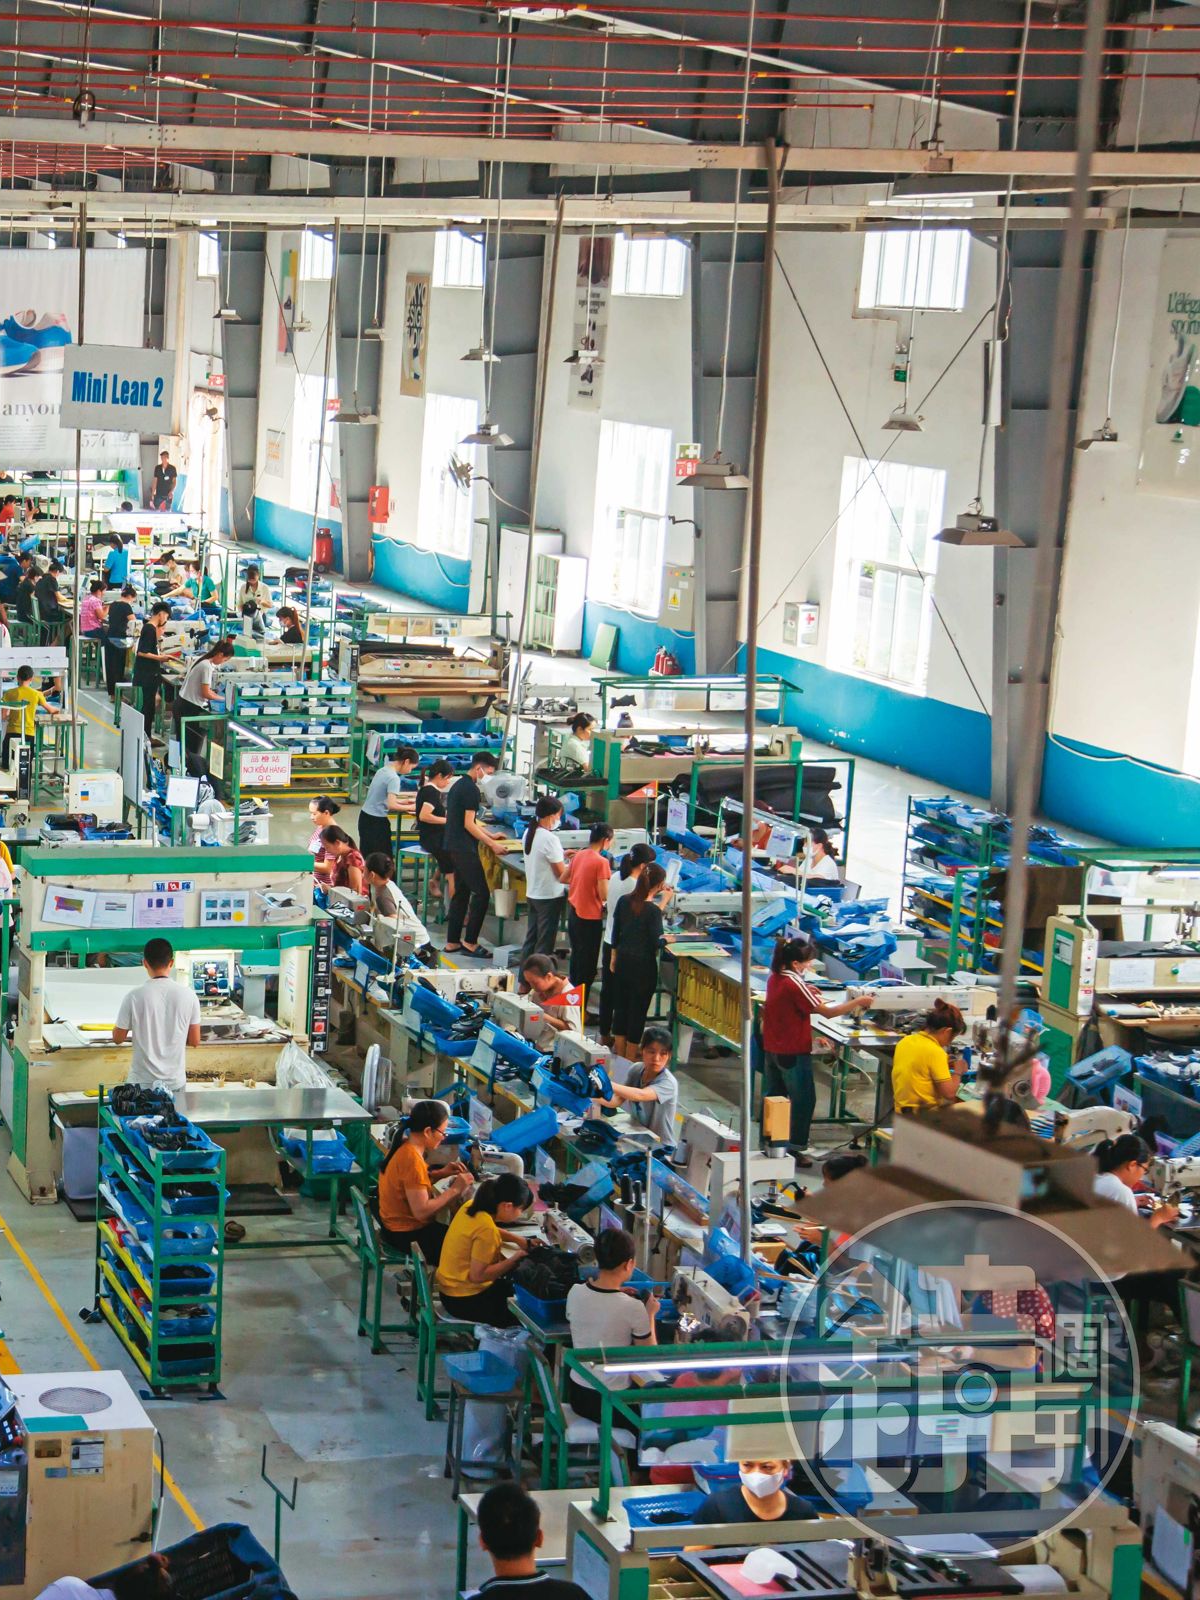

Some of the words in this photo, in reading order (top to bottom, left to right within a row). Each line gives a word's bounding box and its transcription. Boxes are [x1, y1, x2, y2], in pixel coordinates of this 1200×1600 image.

[72, 371, 107, 403] Mini
[112, 374, 149, 407] Lean
[153, 377, 164, 408] 2
[2, 401, 61, 422] anyon
